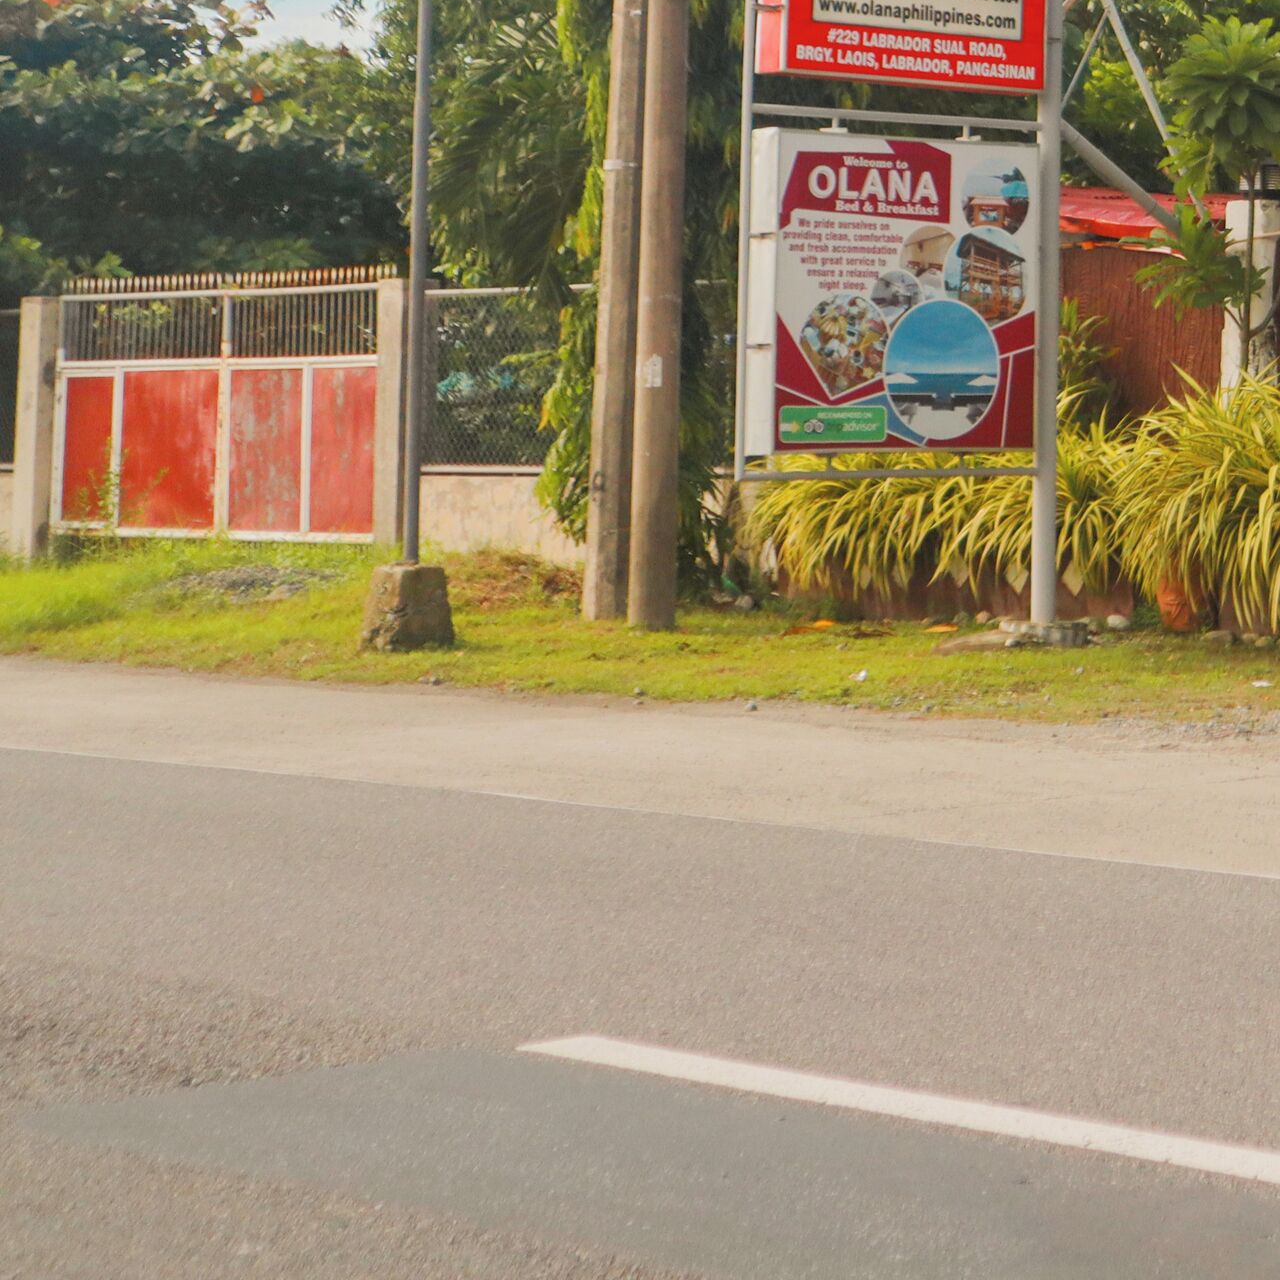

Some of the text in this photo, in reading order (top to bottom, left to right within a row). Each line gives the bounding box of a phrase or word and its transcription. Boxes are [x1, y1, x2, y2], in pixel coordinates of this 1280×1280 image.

[827, 28, 1007, 61] #229 LABRADOR SUAL ROAD,
[796, 43, 1036, 81] BRGY. LAOIS, LABRADOR, PANGASINAN
[843, 155, 909, 170] Welcome to
[808, 164, 939, 204] OLANA
[835, 200, 940, 216] Bed & Breakfast
[797, 218, 811, 228] We
[813, 219, 836, 230] pride
[838, 220, 878, 231] ourselves
[783, 231, 822, 242] providing
[853, 232, 904, 244] comfortable
[788, 243, 805, 252] and
[800, 255, 818, 265] with
[845, 257, 876, 267] service
